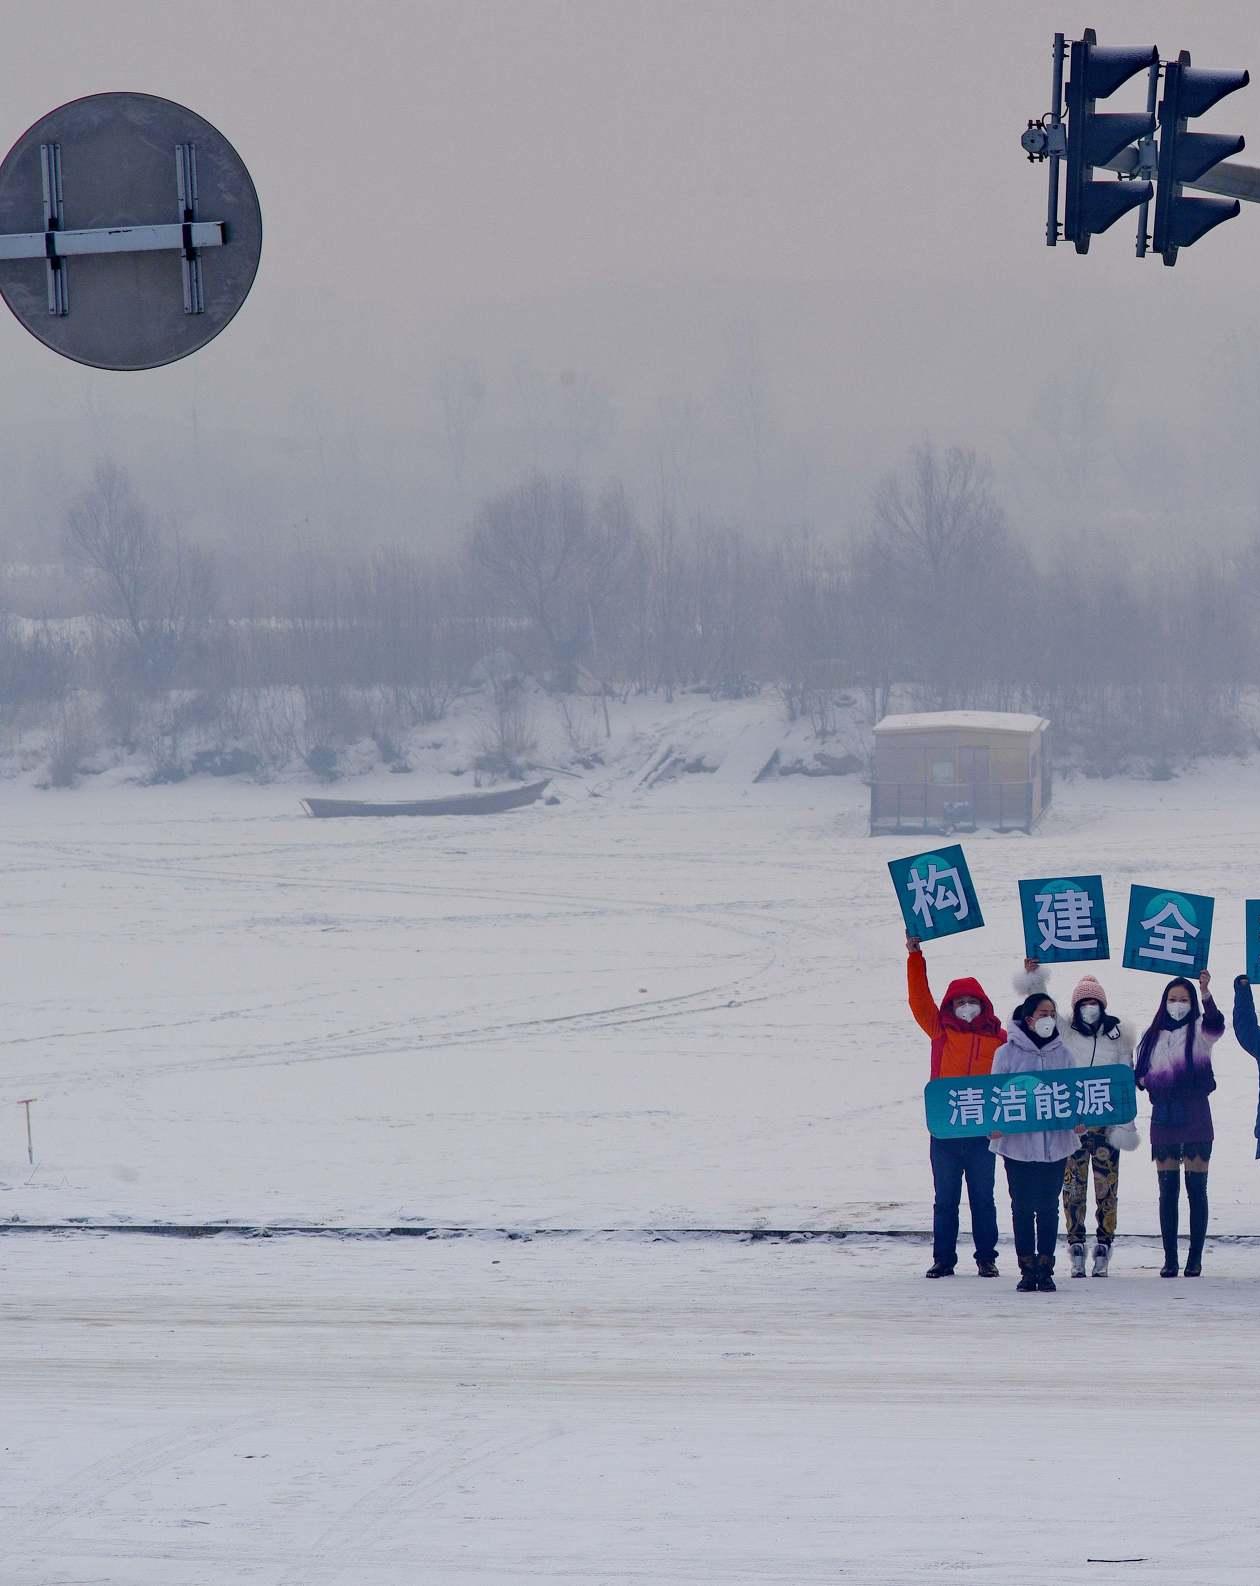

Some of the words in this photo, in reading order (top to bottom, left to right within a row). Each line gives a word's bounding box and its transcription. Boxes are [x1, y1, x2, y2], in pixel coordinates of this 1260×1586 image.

[906, 864, 969, 928] 构
[1034, 889, 1098, 952] 建
[1138, 902, 1200, 965] 全
[948, 1076, 1114, 1126] 清洁能源
